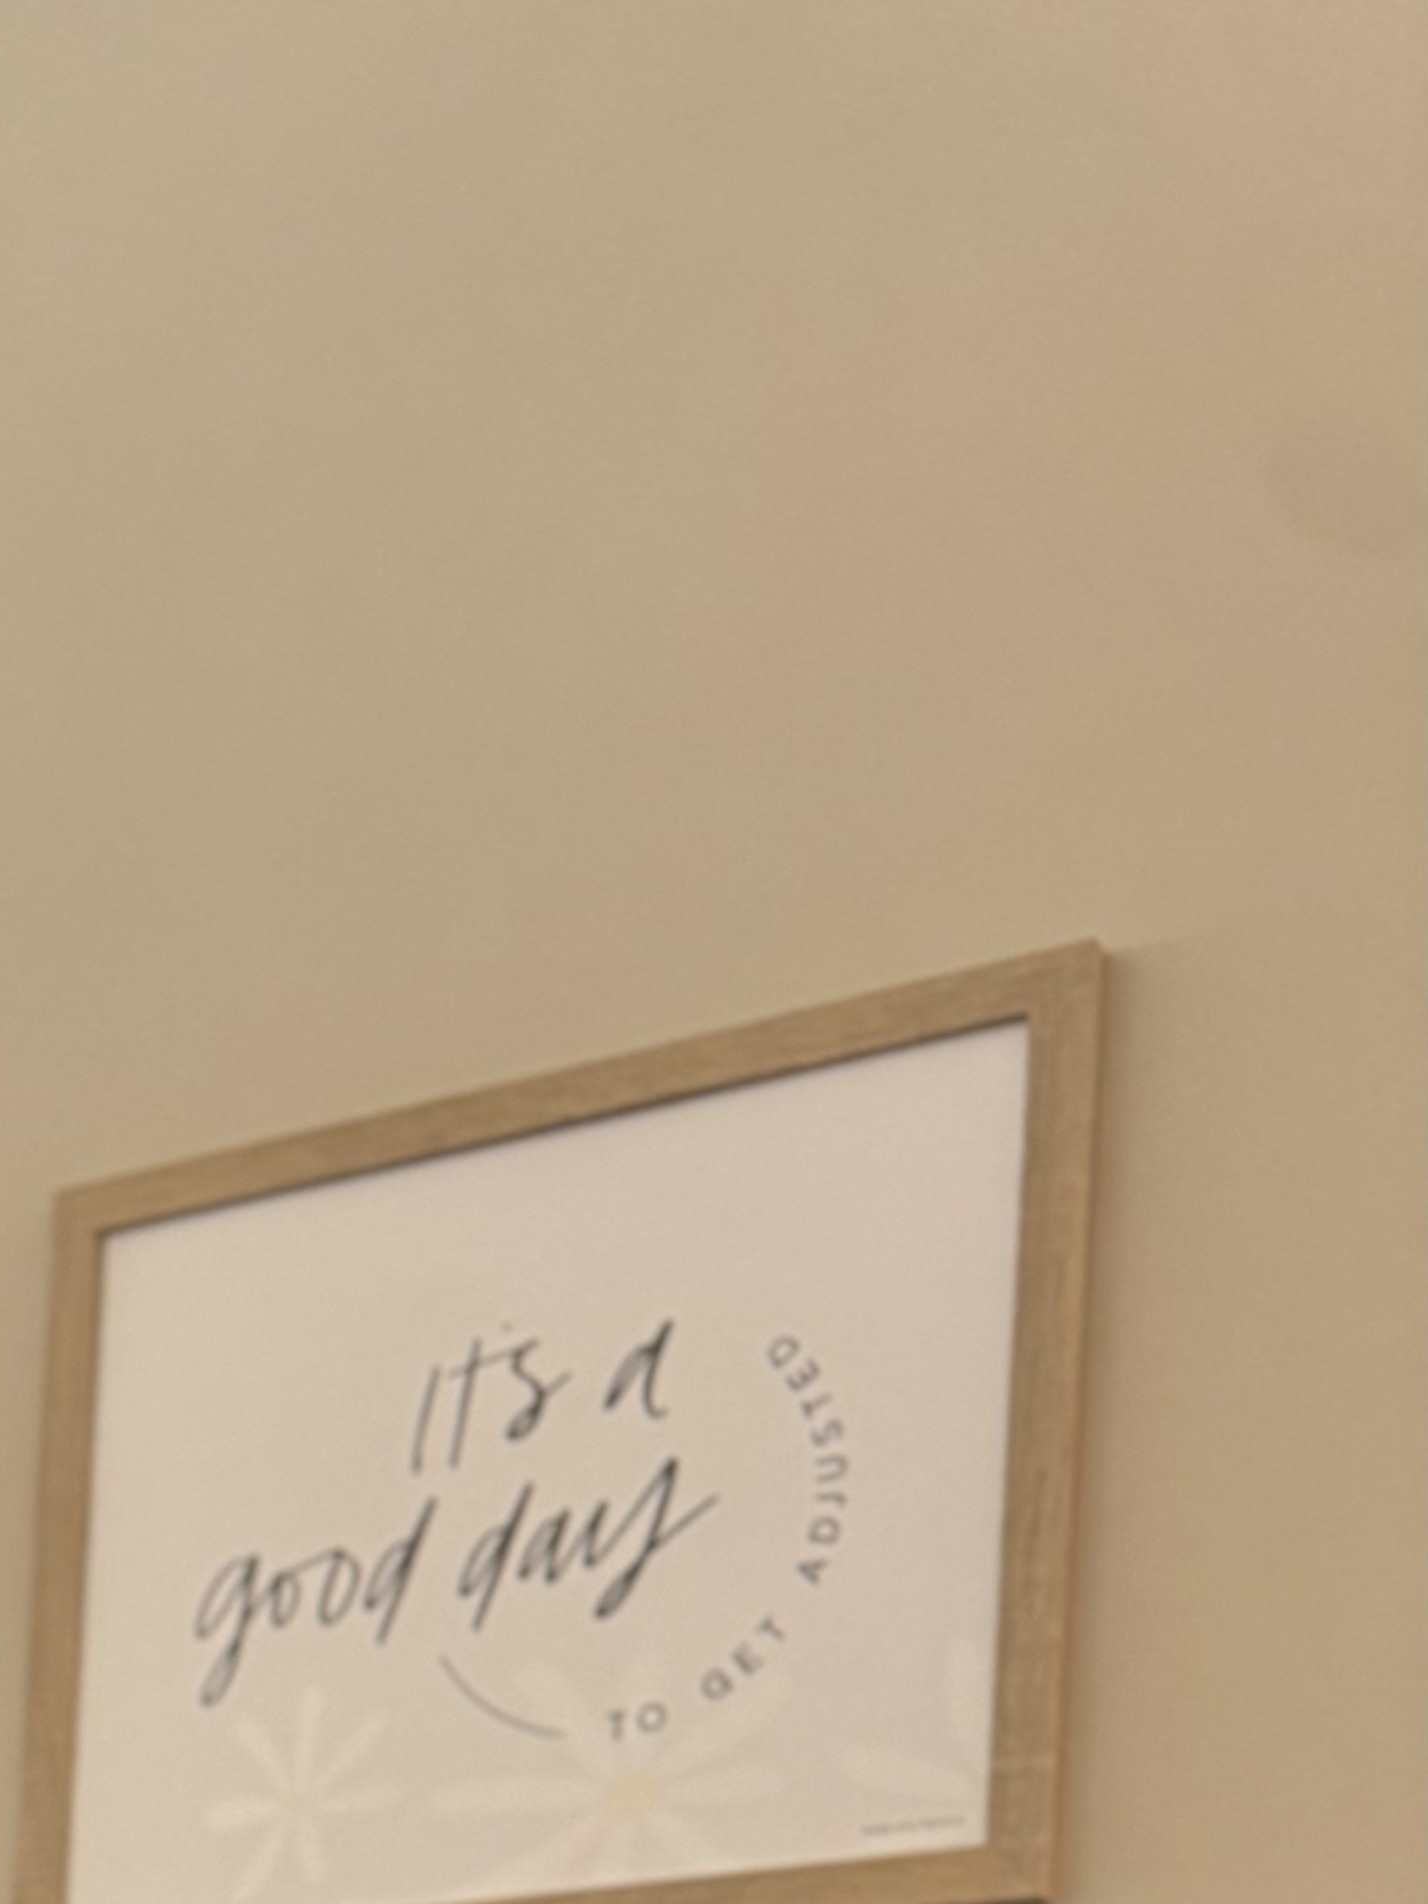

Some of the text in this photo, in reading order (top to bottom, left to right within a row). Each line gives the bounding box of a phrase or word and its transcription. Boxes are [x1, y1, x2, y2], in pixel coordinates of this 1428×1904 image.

[600, 1317, 674, 1420] a
[194, 1455, 720, 1709] good day
[608, 1333, 851, 1742] TO GET ADJUSTED
